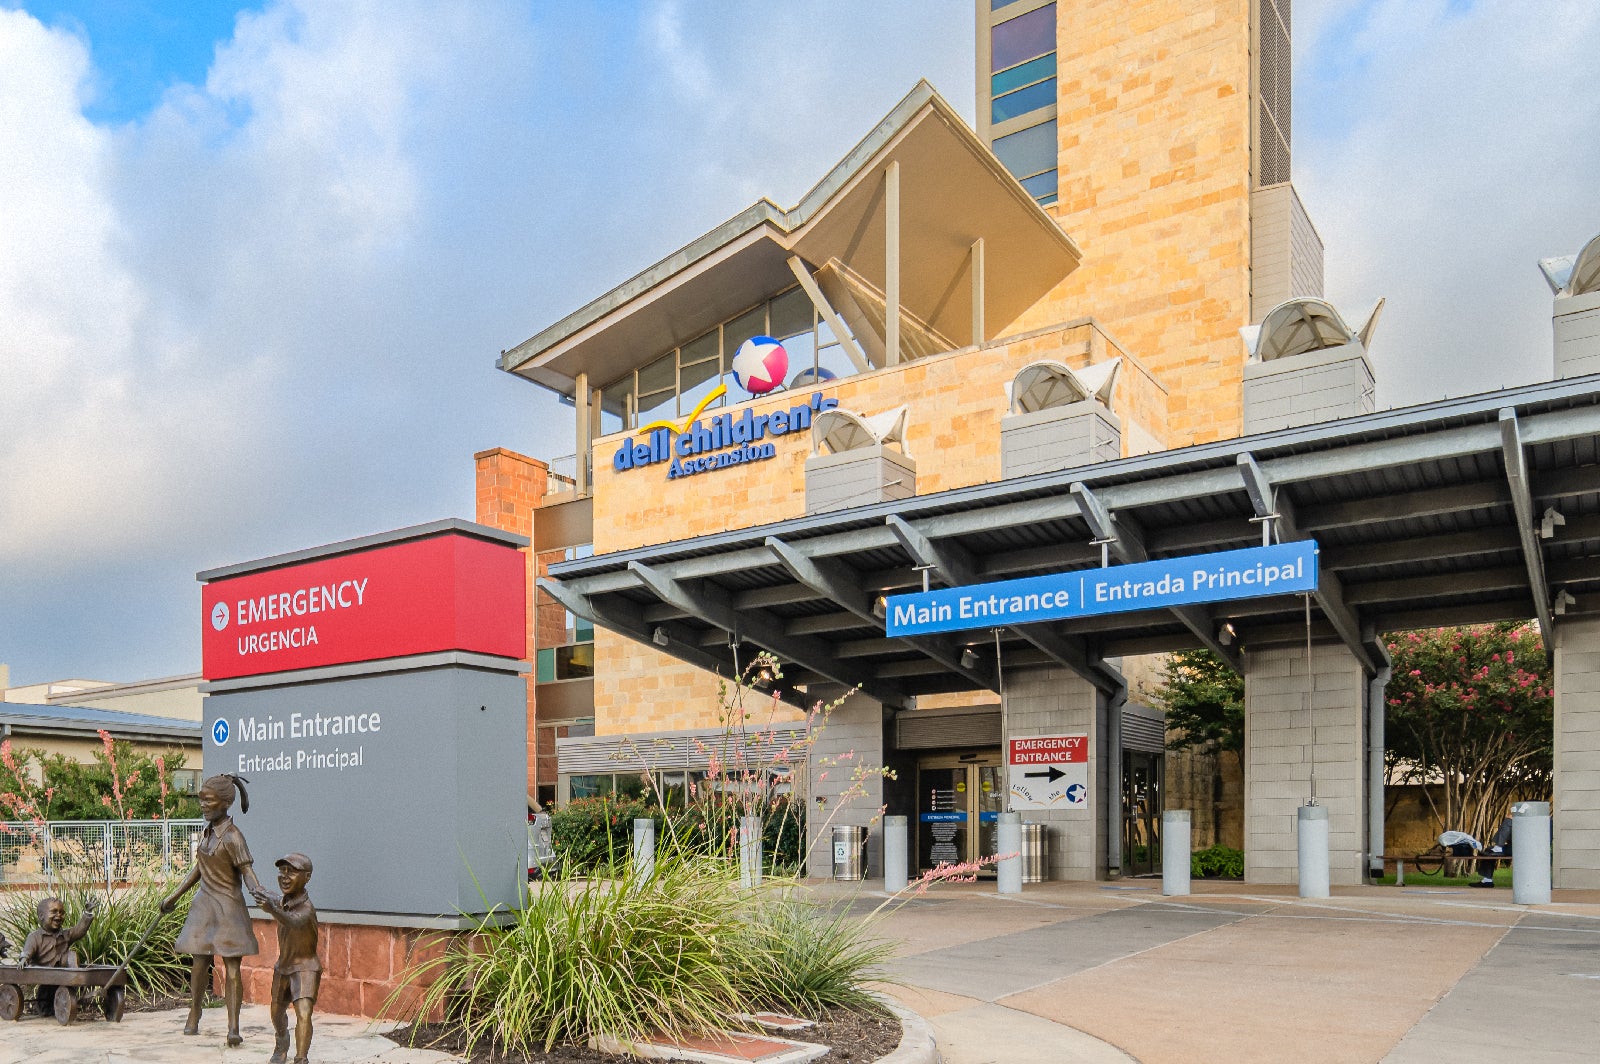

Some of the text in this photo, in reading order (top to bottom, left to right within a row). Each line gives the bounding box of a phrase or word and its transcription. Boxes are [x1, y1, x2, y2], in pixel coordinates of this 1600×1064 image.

[613, 428, 670, 471] dell
[667, 441, 776, 479] Ascension
[237, 578, 369, 625] EMERGENCY
[893, 557, 1303, 627] Main Entrance Entrada Principal
[238, 625, 319, 656] URGENCIA
[238, 712, 381, 742] Main Entrance
[1015, 738, 1081, 750] EMERGENCY
[1015, 752, 1072, 763] ENTRANCE
[238, 746, 363, 773] Entrada Principal
[1048, 790, 1060, 800] the
